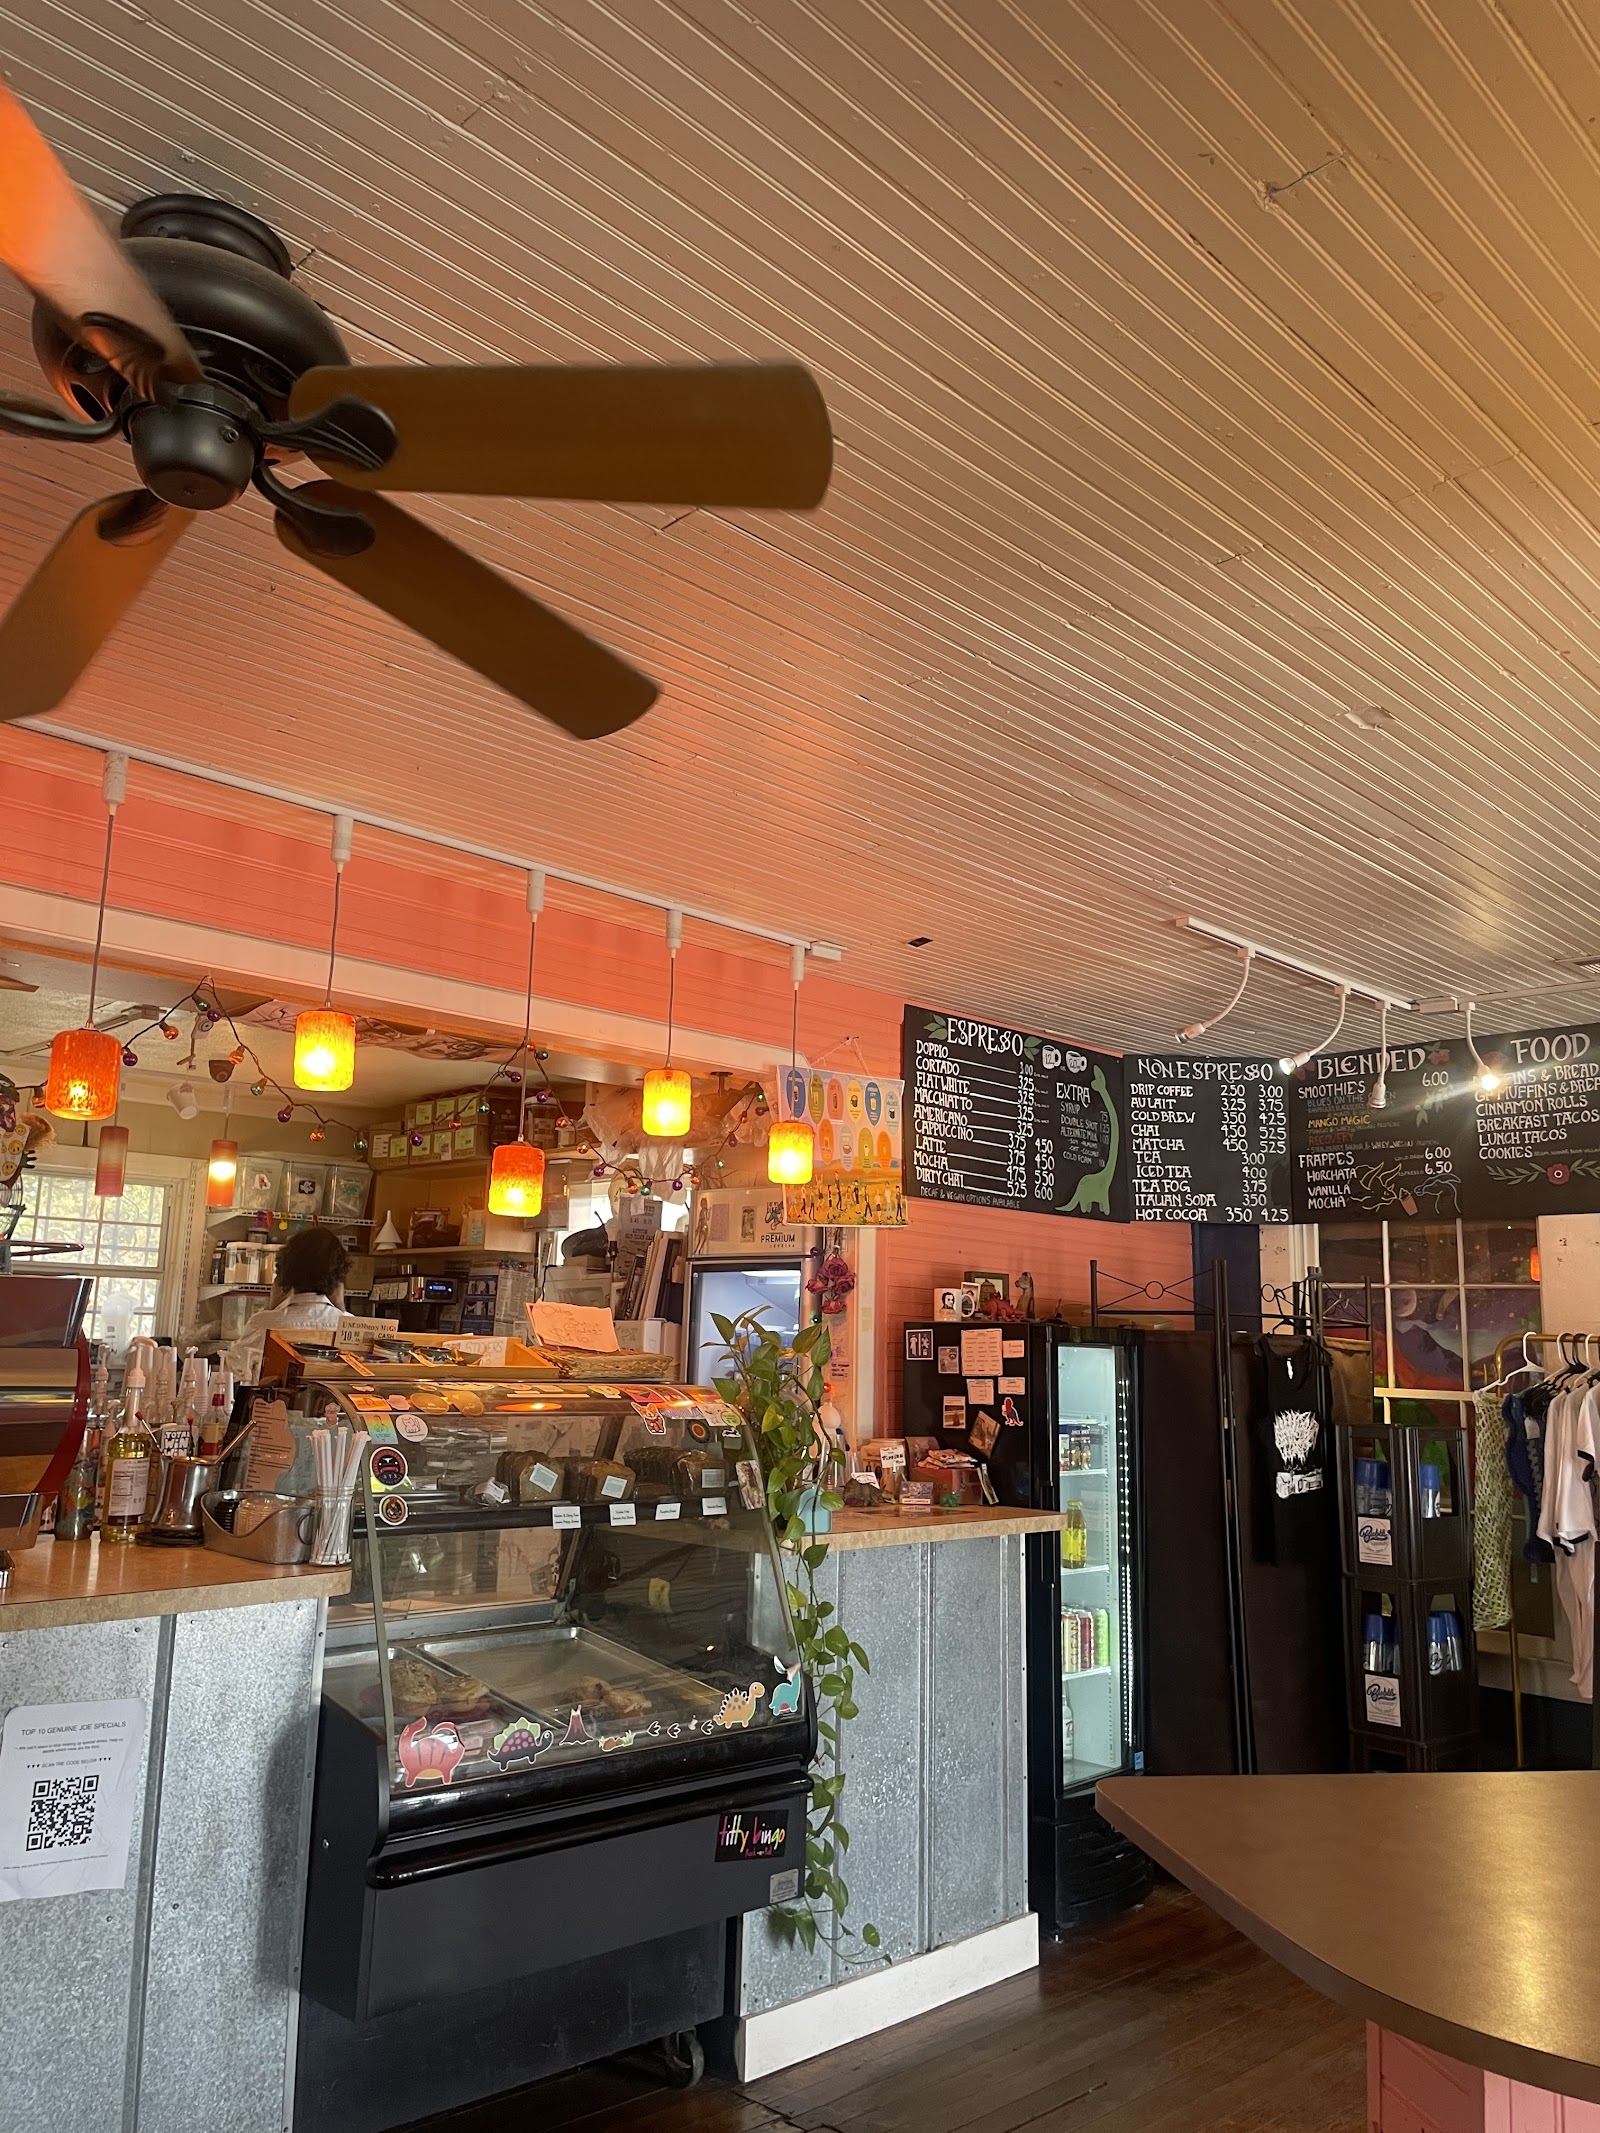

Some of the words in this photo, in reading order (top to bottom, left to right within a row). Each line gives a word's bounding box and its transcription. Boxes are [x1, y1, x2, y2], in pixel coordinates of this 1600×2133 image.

[947, 1017, 1024, 1056] ESPRESSO
[916, 1039, 948, 1058] DOPPIO
[1510, 1033, 1590, 1064] FOOD
[915, 1056, 960, 1076] CORTADO
[1137, 1058, 1174, 1079] NON
[1176, 1061, 1273, 1083] ESPRESSO
[1317, 1047, 1426, 1079] BLENDED
[1541, 1069, 1552, 1081] &
[1553, 1063, 1599, 1080] BREAD
[940, 1076, 970, 1094] WHITE
[1130, 1083, 1155, 1095] DRIP
[1157, 1085, 1194, 1097] COFFEE
[1220, 1084, 1245, 1097] 2.50
[1258, 1084, 1283, 1098] 3.00
[1298, 1080, 1366, 1099] SMOOTHIES
[1422, 1071, 1449, 1087] 6.00
[1497, 1083, 1557, 1100] MUFFINS
[1560, 1082, 1570, 1094] &
[914, 1087, 973, 1110] MACCHIATTO
[1056, 1082, 1091, 1108] EXTRA
[1307, 1097, 1331, 1107] BLUES
[1334, 1096, 1345, 1104] ON
[1346, 1094, 1365, 1103] THE
[1060, 1101, 1080, 1114] SYRUP
[1131, 1097, 1146, 1108] AU
[1147, 1097, 1176, 1109] LAIT
[1221, 1097, 1246, 1111] 3.25
[1258, 1099, 1283, 1112] 3.75
[1476, 1098, 1544, 1116] CINNAMON
[1547, 1095, 1588, 1111] ROLLS
[913, 1103, 967, 1126] AMERICANO
[1060, 1114, 1084, 1128] DOUBLE
[1131, 1110, 1160, 1121] COLD
[1160, 1111, 1196, 1123] BREW
[1259, 1112, 1286, 1125] 4.25
[1308, 1118, 1338, 1128] MANGO
[1340, 1115, 1371, 1125] MAGIC
[1476, 1114, 1549, 1132] BREAKFAST
[1553, 1109, 1600, 1126] TACOS
[915, 1119, 974, 1141] CAPPUCCINO
[1008, 1133, 1026, 1150] 3.75
[1131, 1124, 1160, 1136] CHAI
[1220, 1124, 1246, 1138] 4.50
[1309, 1132, 1354, 1145] RECOVERY
[1479, 1131, 1520, 1146] LUNCH
[1522, 1128, 1568, 1143] TACOS
[915, 1134, 946, 1154] LATTE
[1132, 1138, 1185, 1150] MATCHA
[1371, 1140, 1389, 1149] WHEY
[1479, 1145, 1533, 1160] COOKIES
[913, 1150, 948, 1170] MOCHA
[1063, 1151, 1077, 1161] COLD
[1133, 1151, 1162, 1163] TEA
[1241, 1152, 1265, 1165] 3.00
[1298, 1151, 1354, 1168] FRAPPES
[1424, 1147, 1451, 1160] 6.00
[915, 1166, 942, 1184] DIRTY
[942, 1173, 964, 1188] CHAI
[1136, 1165, 1164, 1178] ICED
[1165, 1166, 1192, 1178] TEA
[1242, 1166, 1267, 1179] 4.00
[1307, 1167, 1357, 1182] HORCHATA
[1424, 1161, 1452, 1175] 6.50
[1132, 1179, 1160, 1192] TEA
[1161, 1180, 1191, 1192] FOG
[1242, 1179, 1267, 1193] 3.75
[1307, 1184, 1351, 1197] VANILLA
[920, 1186, 938, 1197] DECAF
[946, 1191, 965, 1201] VEGAN
[966, 1195, 990, 1205] OPTIONS
[992, 1198, 1020, 1209] AVAILABLE
[1135, 1194, 1182, 1207] ITALIAN
[1185, 1194, 1217, 1206] SODA
[1308, 1197, 1346, 1209] MOCHA
[1135, 1208, 1163, 1220] HOT
[1165, 1208, 1208, 1221] COCOA
[1261, 1208, 1289, 1222] 4.25
[760, 1234, 795, 1243] PREMIUM
[342, 1322, 379, 1331] UNCOMMON
[47, 1725, 77, 1734] GENUINE
[79, 1723, 92, 1731] JOE
[94, 1721, 126, 1729] SPECIALS
[719, 1815, 749, 1853] titty
[752, 1816, 785, 1850] bingo
